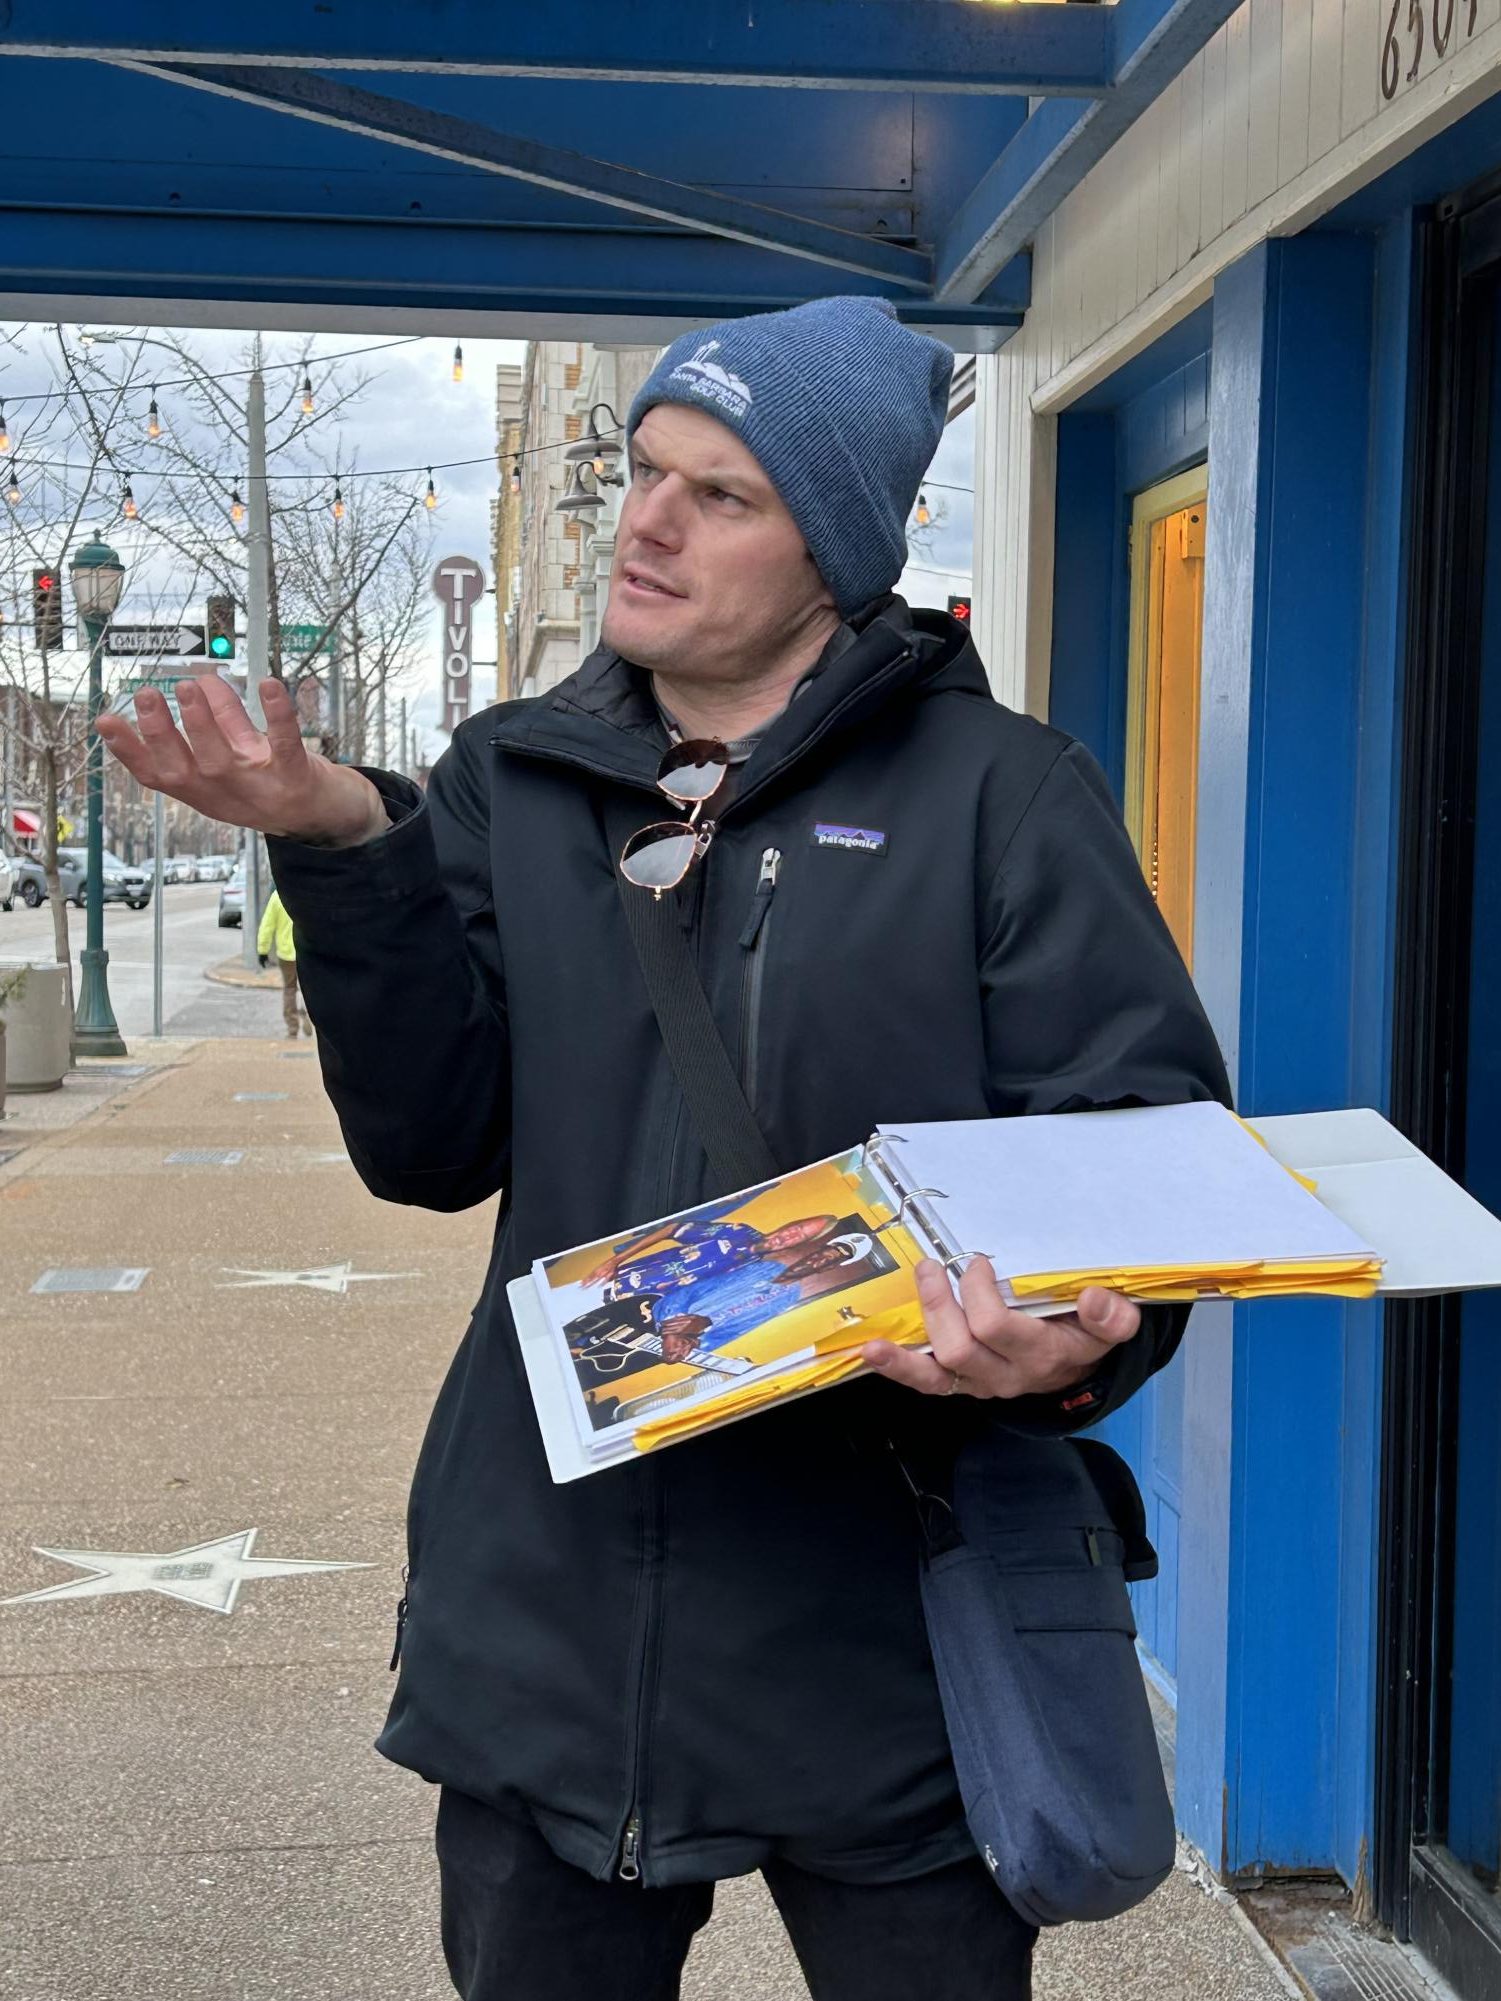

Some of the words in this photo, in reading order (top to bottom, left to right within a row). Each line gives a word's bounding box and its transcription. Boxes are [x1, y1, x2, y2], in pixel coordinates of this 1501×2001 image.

[689, 382, 717, 398] GOLF
[715, 394, 744, 417] CLUB
[700, 377, 748, 410] BARBARA
[114, 634, 142, 647] ONE
[149, 634, 180, 647] WAY
[440, 567, 478, 730] TIVOLI
[818, 834, 878, 850] patagonia
